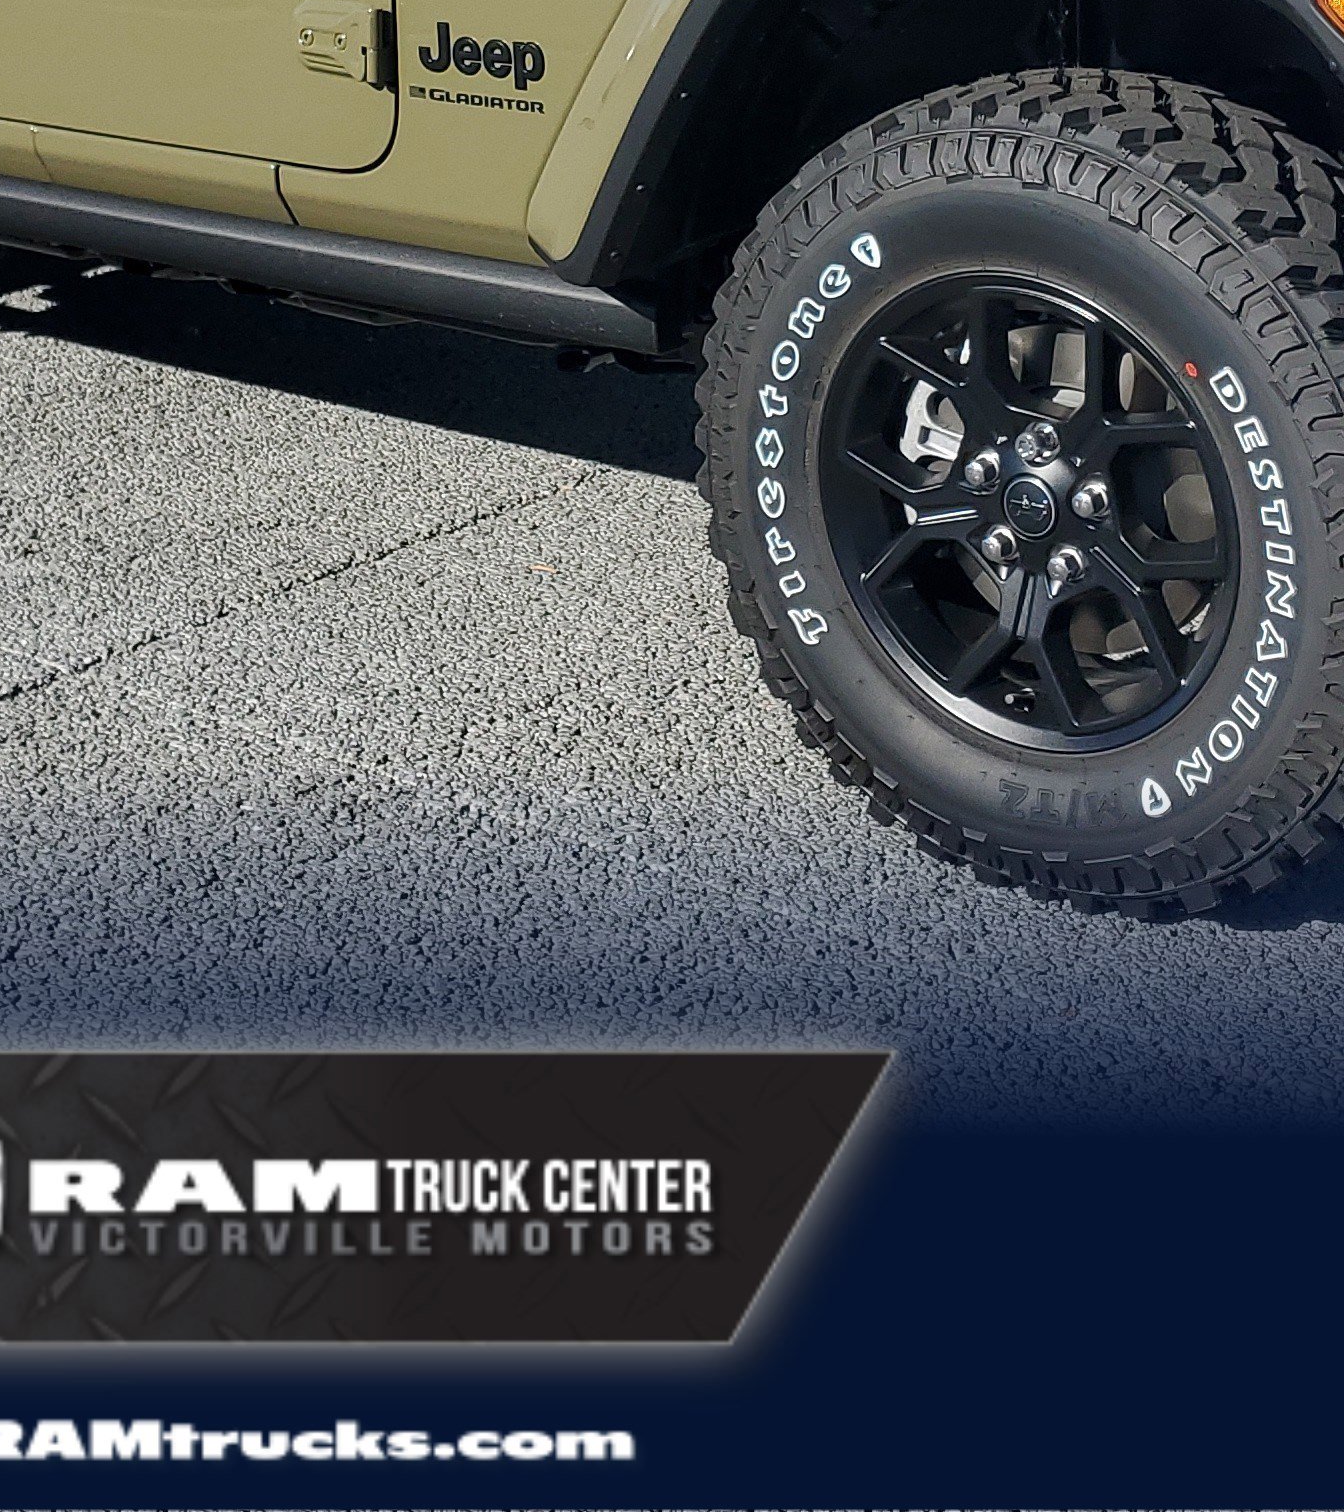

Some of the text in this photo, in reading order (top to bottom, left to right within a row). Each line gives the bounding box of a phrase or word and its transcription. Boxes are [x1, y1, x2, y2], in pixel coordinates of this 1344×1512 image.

[418, 21, 546, 90] Jeep
[428, 87, 545, 115] GLADIATOR
[755, 262, 852, 645] Firestone
[1176, 366, 1298, 796] DESTINATION
